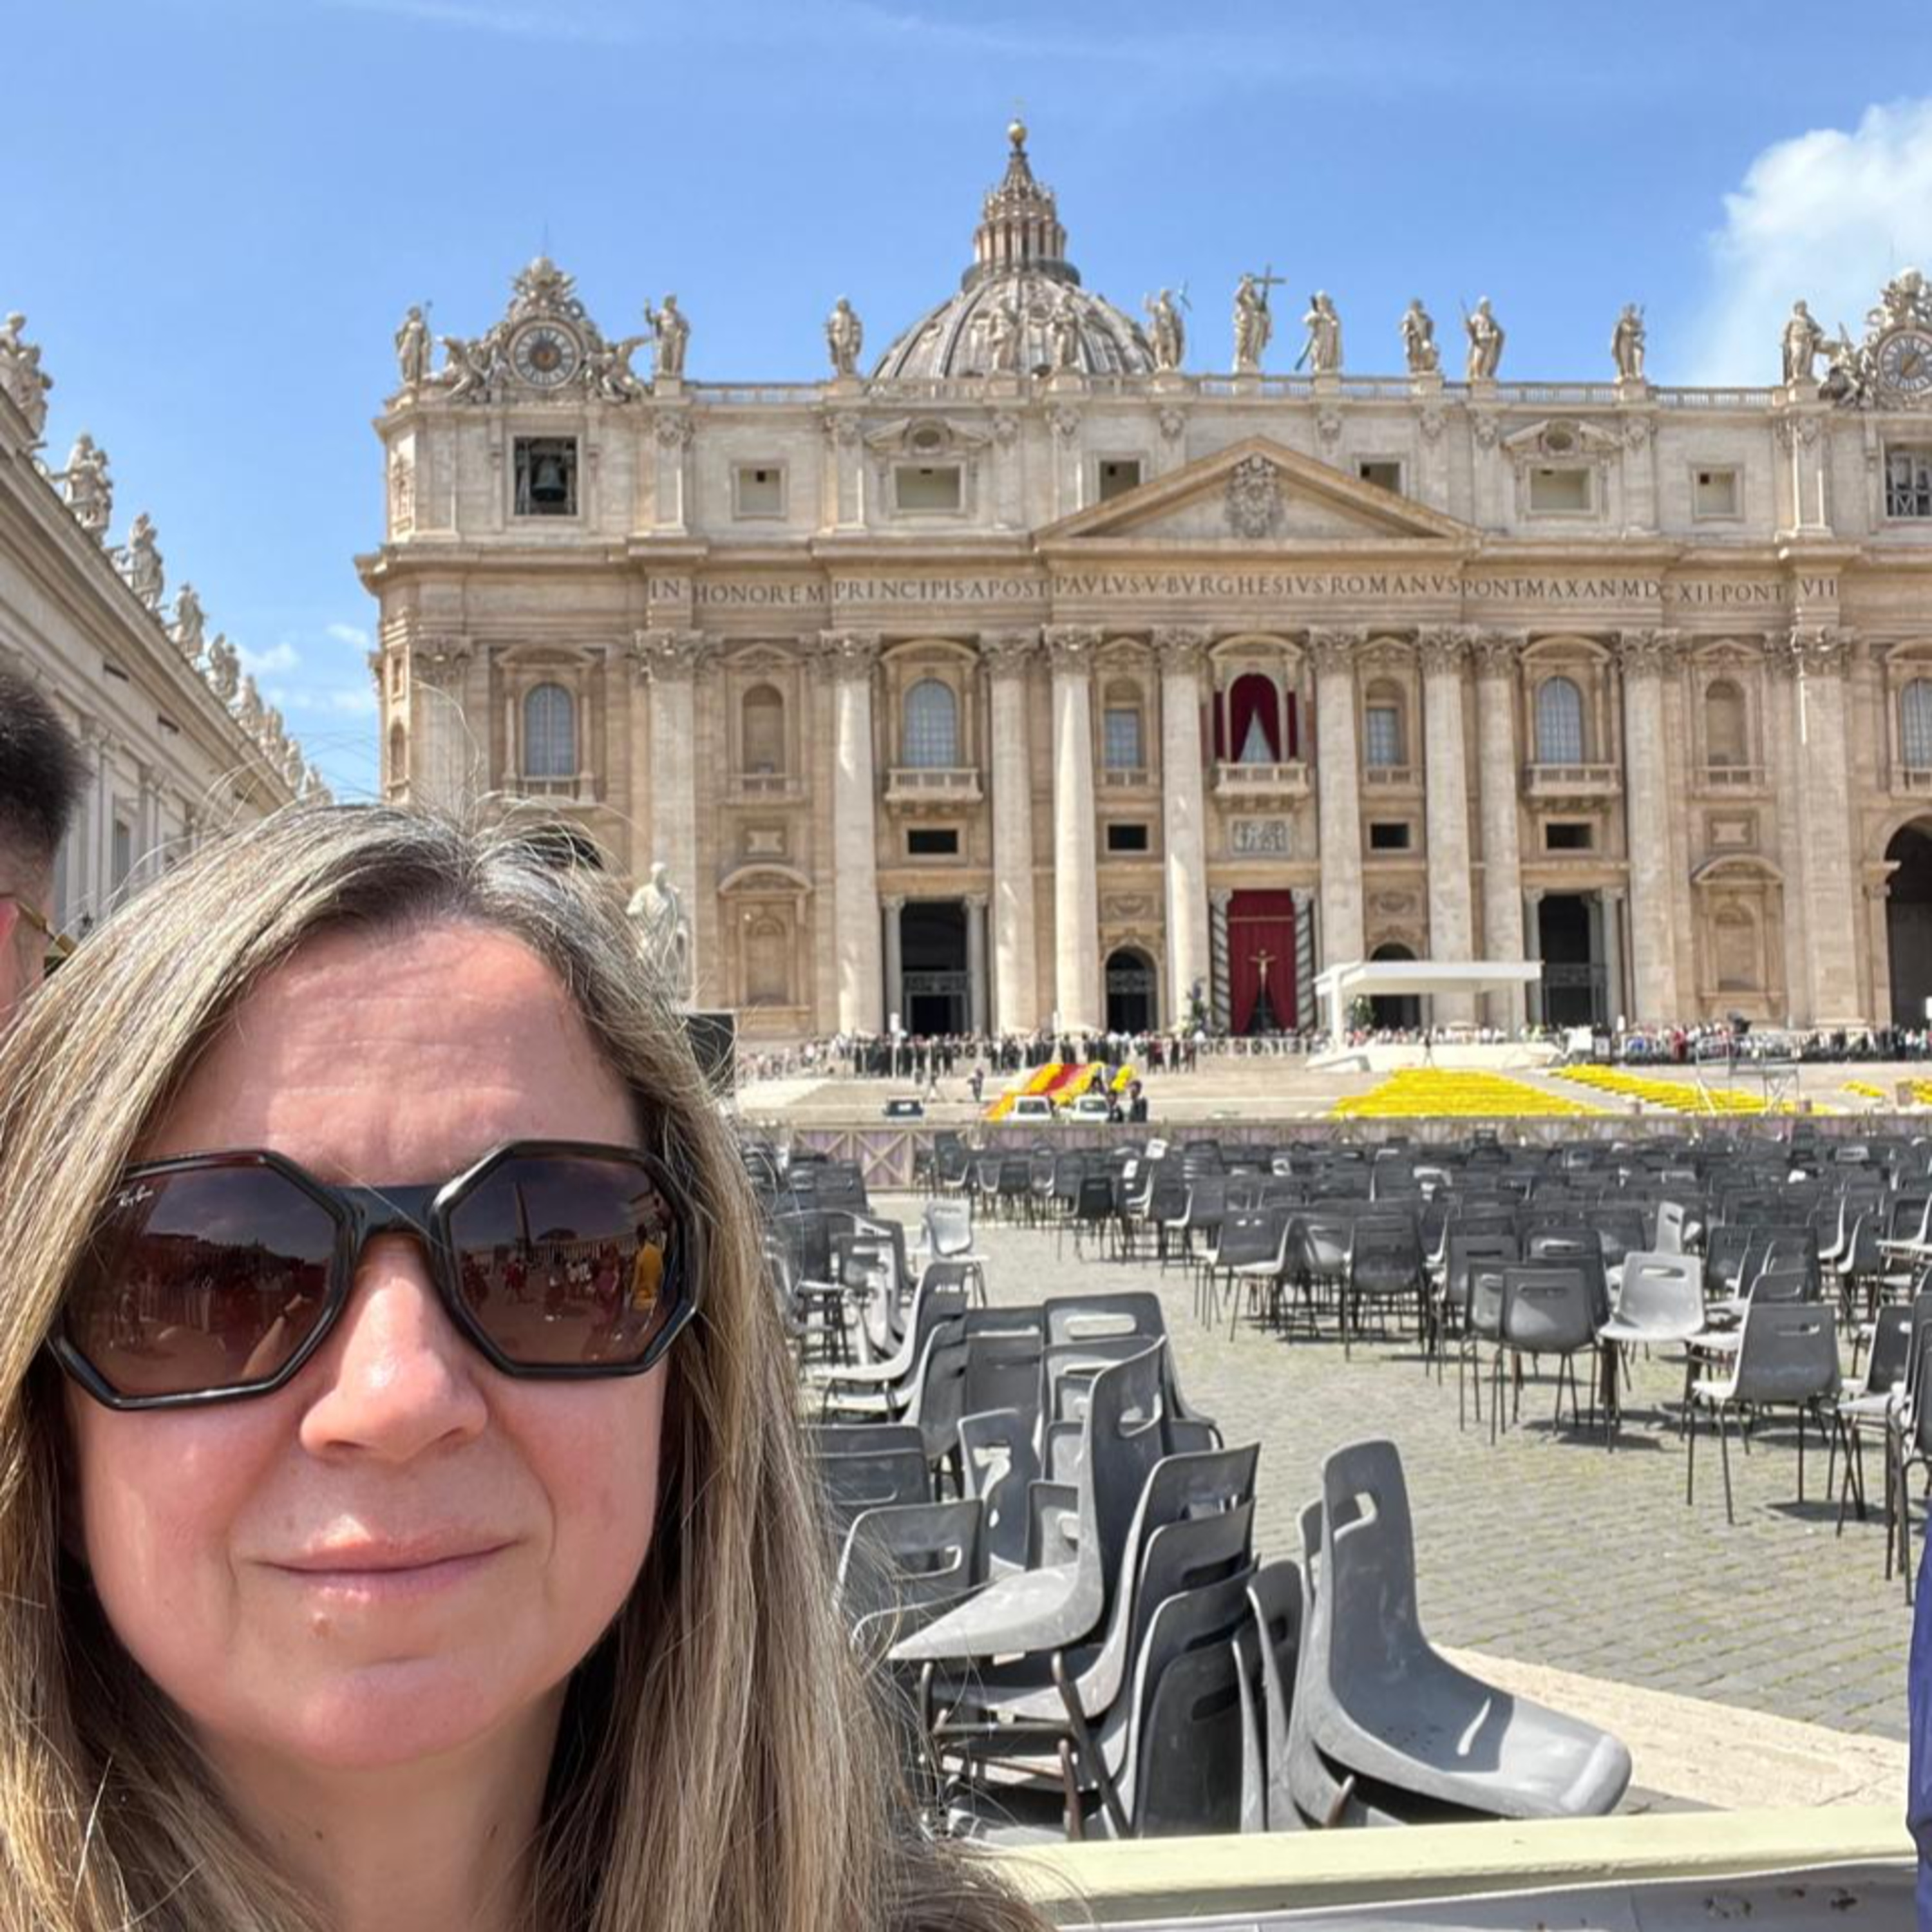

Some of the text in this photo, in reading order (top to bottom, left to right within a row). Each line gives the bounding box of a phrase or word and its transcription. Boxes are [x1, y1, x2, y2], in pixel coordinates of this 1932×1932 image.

[651, 580, 680, 599] IN
[693, 585, 824, 603] HONOREM
[835, 580, 964, 599] PRINCIPIS
[969, 580, 1049, 598] APOST
[1055, 576, 1141, 595] PAVLVS
[1166, 576, 1324, 595] BVRGHESIVS
[1331, 576, 1458, 595] ROMANVS
[1462, 580, 1522, 598] PONT
[1526, 580, 1578, 598] MAX
[1583, 580, 1615, 598] AN
[1721, 583, 1783, 603] PONT
[1802, 579, 1835, 597] VII
